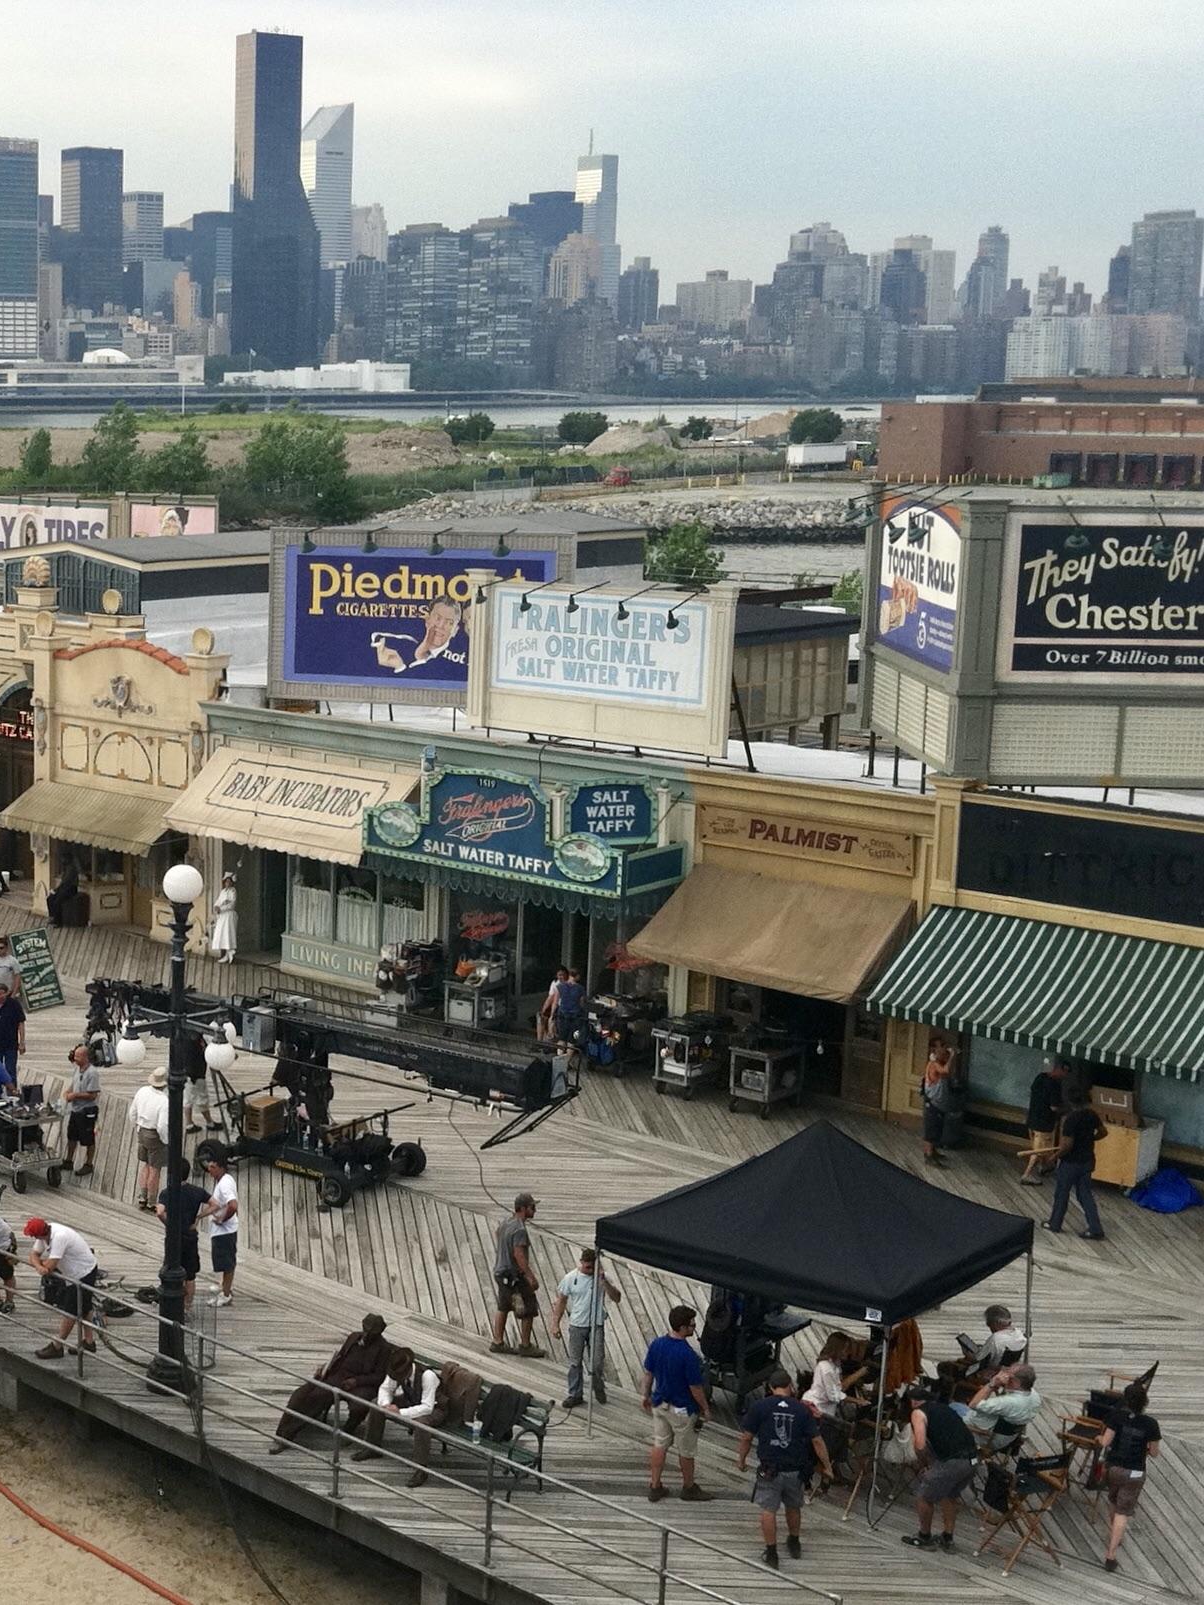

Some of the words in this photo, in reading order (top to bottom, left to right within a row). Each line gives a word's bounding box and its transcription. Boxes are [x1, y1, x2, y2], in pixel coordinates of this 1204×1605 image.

[44, 518, 105, 543] TIRES
[888, 545, 925, 584] TOOTSIE
[927, 556, 955, 594] ROLLS
[1024, 549, 1096, 606] They
[309, 563, 526, 615] Piedmo
[336, 602, 431, 618] CIGARETTES
[511, 602, 692, 644] FRALINGERS
[1046, 593, 1204, 631] Chester
[443, 649, 466, 665] not
[546, 635, 656, 667] ORIGINAL
[1046, 650, 1090, 664] Over
[1096, 650, 1107, 664] 7
[1108, 650, 1169, 665] Billion
[517, 656, 555, 679] SALT
[562, 660, 619, 686] WATER
[625, 667, 680, 692] TAFFY
[222, 772, 273, 801] BABY
[266, 778, 370, 817] INCUBATORS
[586, 804, 636, 817] WATER
[592, 790, 629, 803] SALT
[462, 820, 507, 838] ORIGINAL
[587, 819, 635, 832] TAFFY
[748, 819, 858, 854] PALMIST
[423, 839, 455, 856] SALT
[458, 845, 504, 867] WATER
[507, 853, 553, 875] TAFFY
[291, 944, 341, 970] LIVING
